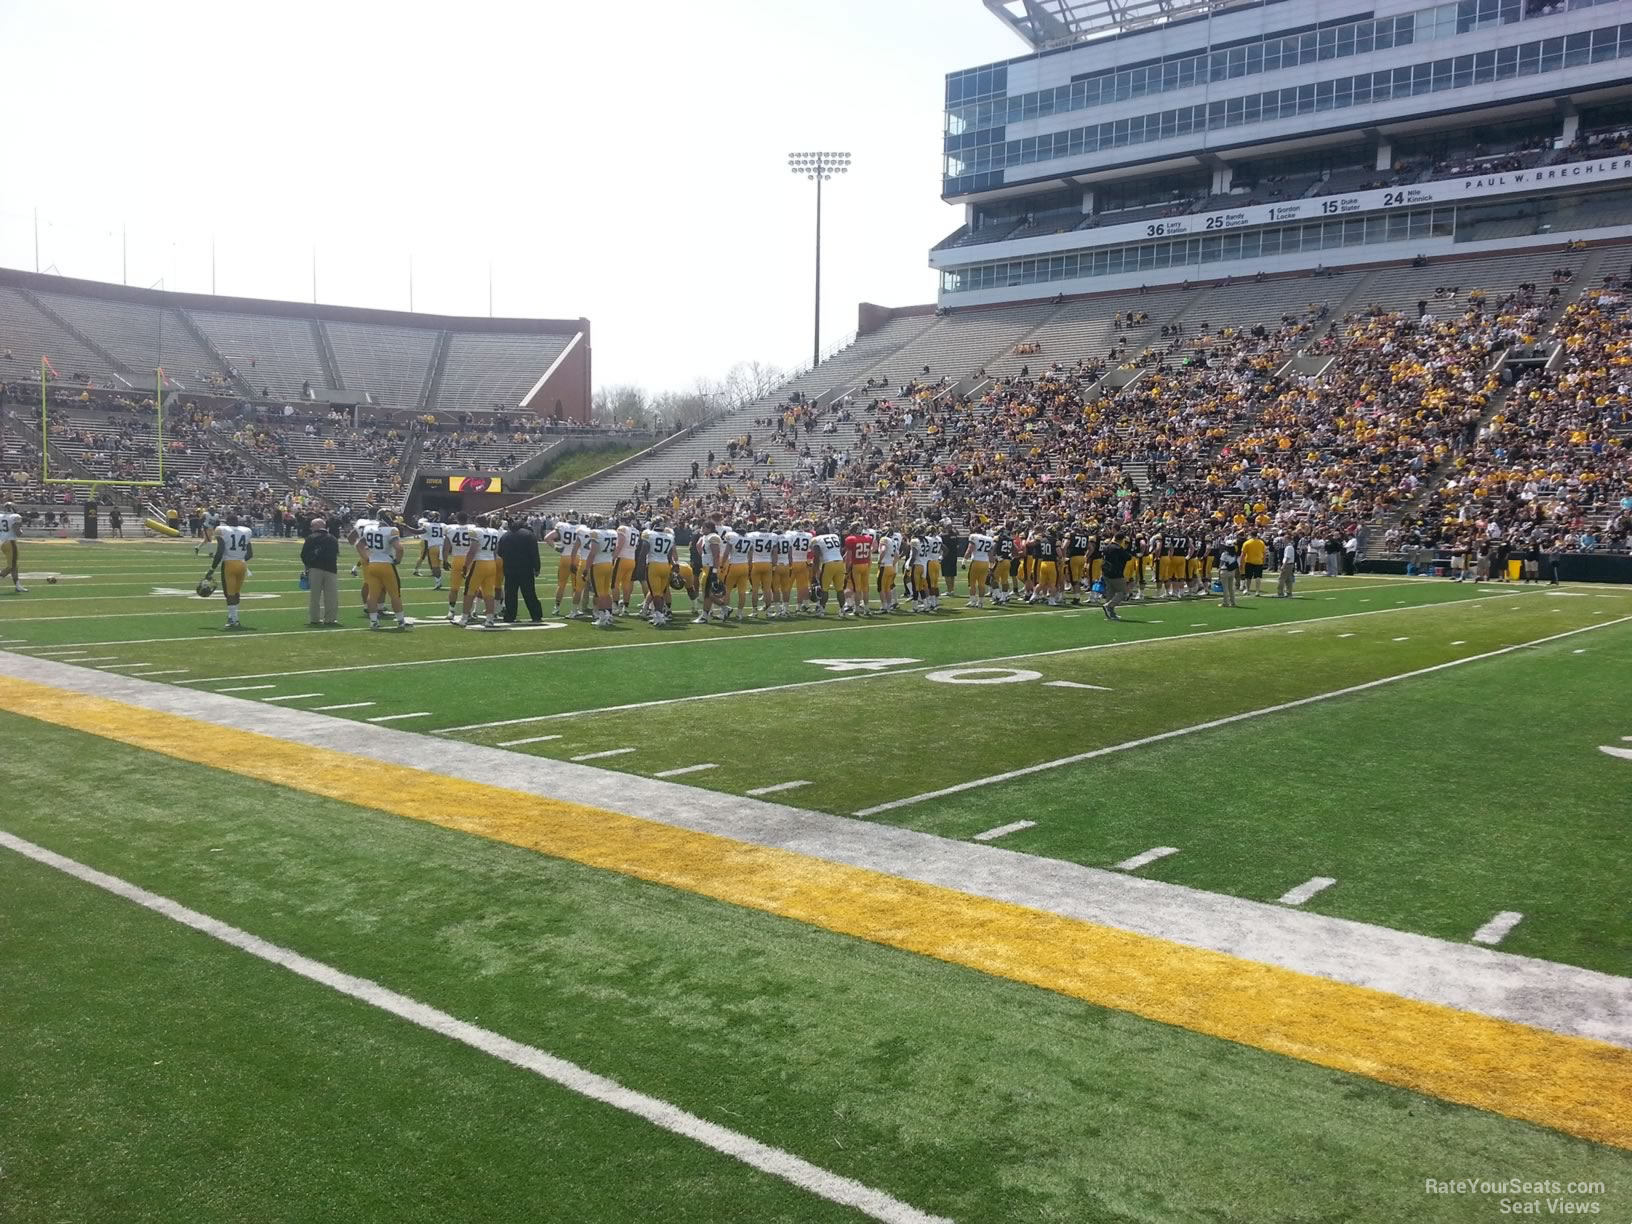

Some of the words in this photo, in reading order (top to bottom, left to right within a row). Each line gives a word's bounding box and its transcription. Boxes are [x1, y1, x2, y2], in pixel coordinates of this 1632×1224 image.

[1465, 177, 1506, 189] PAUL
[1514, 174, 1529, 183] W.
[1535, 159, 1632, 181] BRECHLER
[1383, 191, 1404, 206] 24
[1407, 189, 1421, 197] Nile
[1407, 194, 1433, 204] Kinnick
[1321, 200, 1339, 214] 15
[1340, 197, 1359, 206] Duke
[1268, 208, 1275, 221] 1
[1276, 212, 1297, 220] Locke
[1166, 221, 1182, 230] Larry
[1205, 216, 1224, 230] 25
[1225, 218, 1249, 227] Duncan
[1146, 223, 1165, 237] 36
[431, 526, 443, 538] 51
[229, 534, 246, 551] 14
[366, 532, 384, 550] 99
[481, 534, 498, 552] 78
[602, 537, 618, 553] 75
[654, 537, 672, 554] 97
[735, 539, 751, 554] 47
[755, 539, 773, 553] 54
[793, 537, 809, 552] 43
[823, 537, 840, 550] 56
[932, 541, 942, 554] 27
[977, 539, 992, 553] 72
[1001, 540, 1013, 553] 29
[1074, 536, 1087, 549] 78
[1172, 537, 1187, 549] 77
[855, 542, 871, 559] 25
